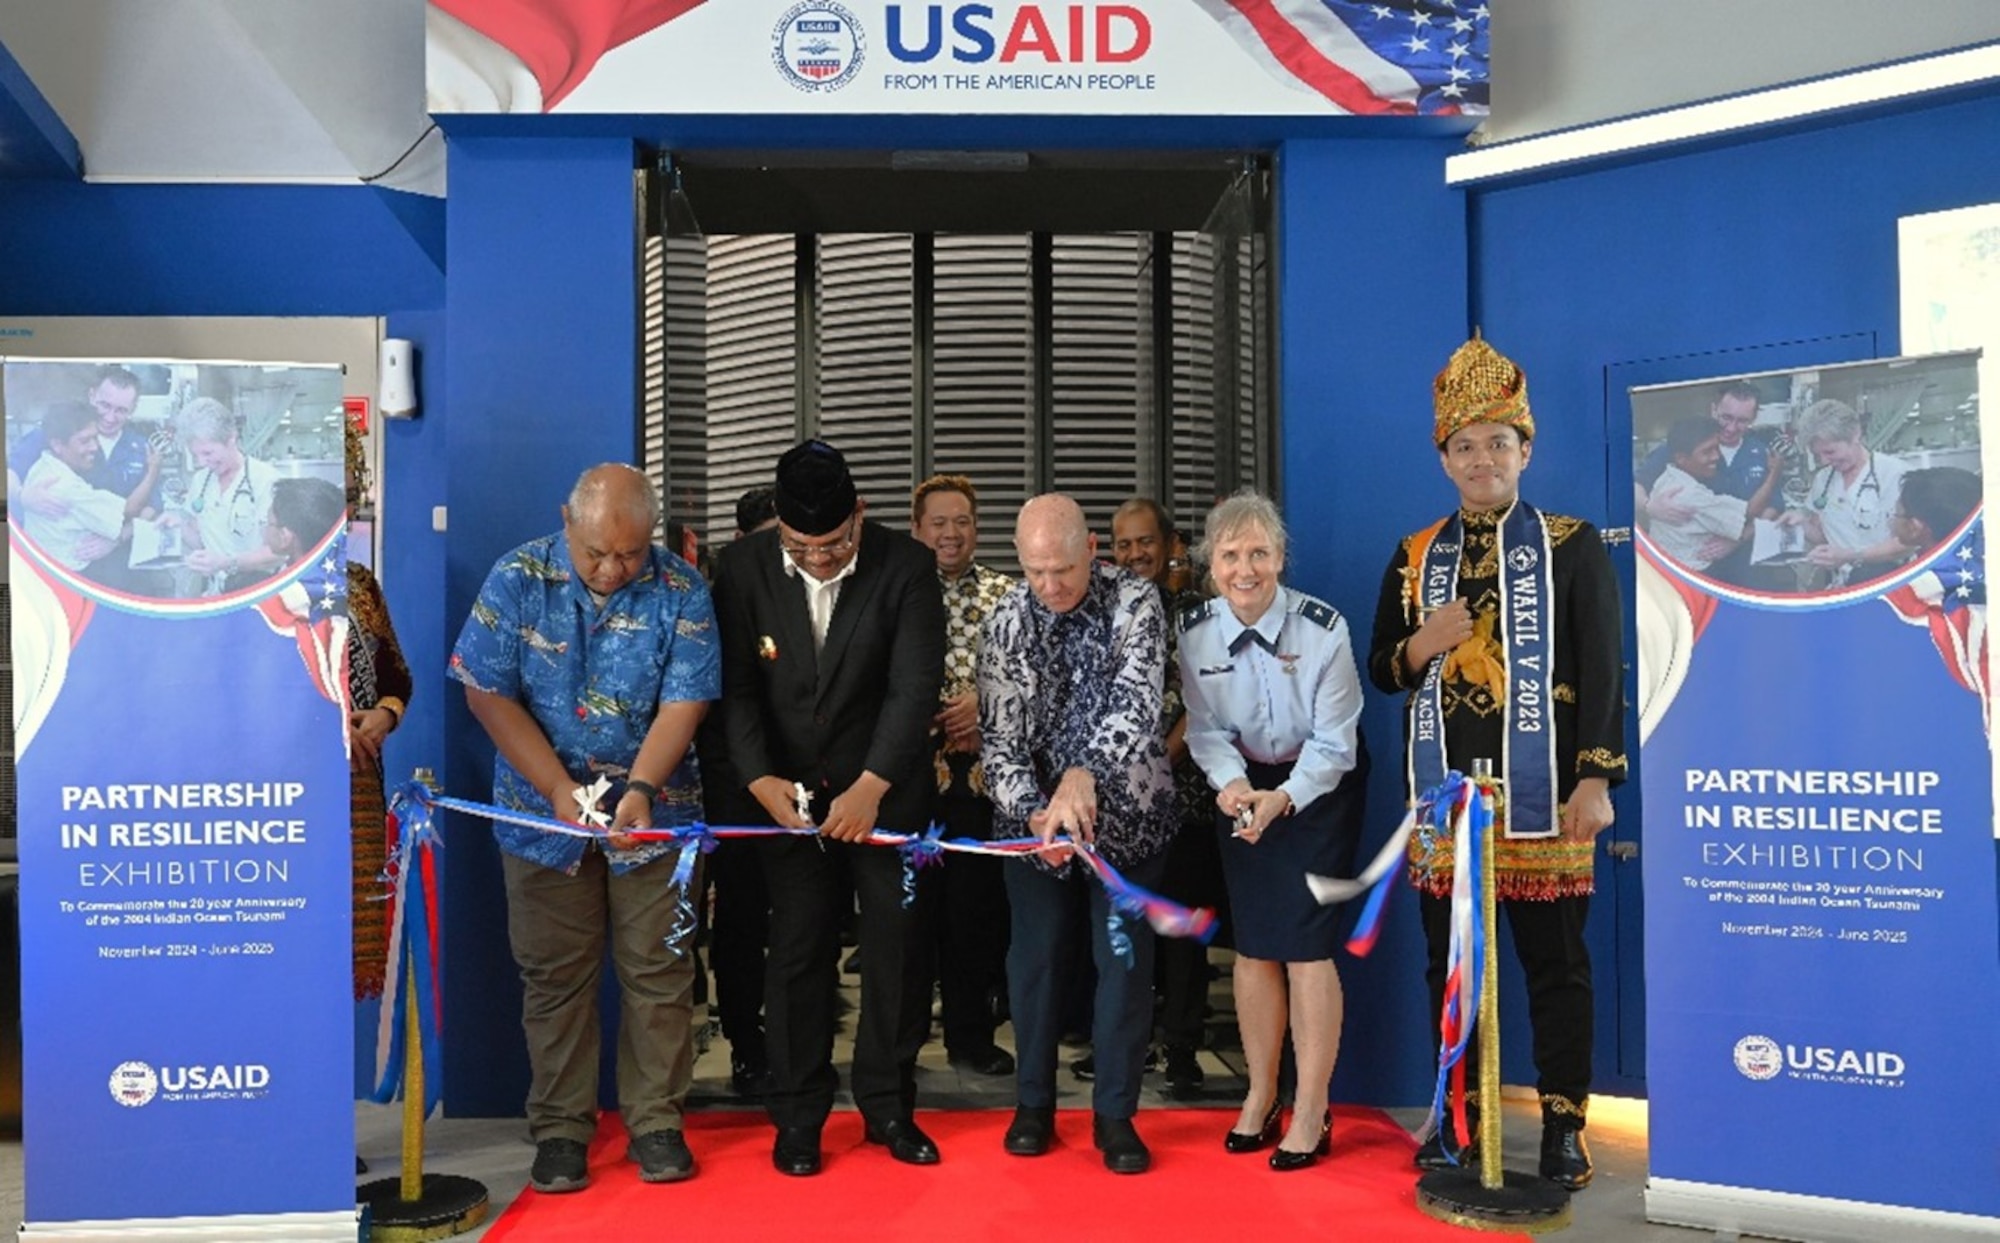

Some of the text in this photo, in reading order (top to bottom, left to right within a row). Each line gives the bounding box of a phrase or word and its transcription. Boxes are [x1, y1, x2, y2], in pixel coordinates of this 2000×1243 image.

[885, 3, 1152, 63] USAID
[884, 74, 937, 90] FROM
[943, 74, 980, 90] THE
[987, 74, 1082, 90] AMERICAN
[1088, 74, 1155, 90] PEOPLE
[1513, 573, 1542, 732] WAKIL V 2023
[1418, 698, 1435, 741] ACEH
[1685, 769, 1940, 796] PARTNERSHIP
[61, 783, 304, 811] PARTNERSHIP
[1684, 805, 1943, 834] IN RESILIENCE
[61, 820, 306, 848] IN RESILIENCE
[1703, 842, 1922, 871] EXHIBITION
[80, 859, 288, 887] EXHIBITION
[1682, 877, 1944, 899] To Commemorate the 20 year Anniversary
[1709, 892, 1920, 911] of the 2004 Indian Ocean Tsunami
[60, 897, 306, 912] To Commemorate the 20 year Anniversary
[86, 911, 285, 926] of the 2004 Indian Ocean Tsunami
[1722, 921, 1788, 937] November
[1790, 925, 1824, 939] 2024
[1836, 928, 1869, 941] June
[1873, 929, 1907, 943] 2025
[98, 945, 162, 958] November
[167, 944, 197, 956] 2024
[208, 944, 240, 956] June
[242, 942, 274, 954] 2025
[1786, 1044, 1905, 1077] USAID
[161, 1065, 270, 1091] USAID
